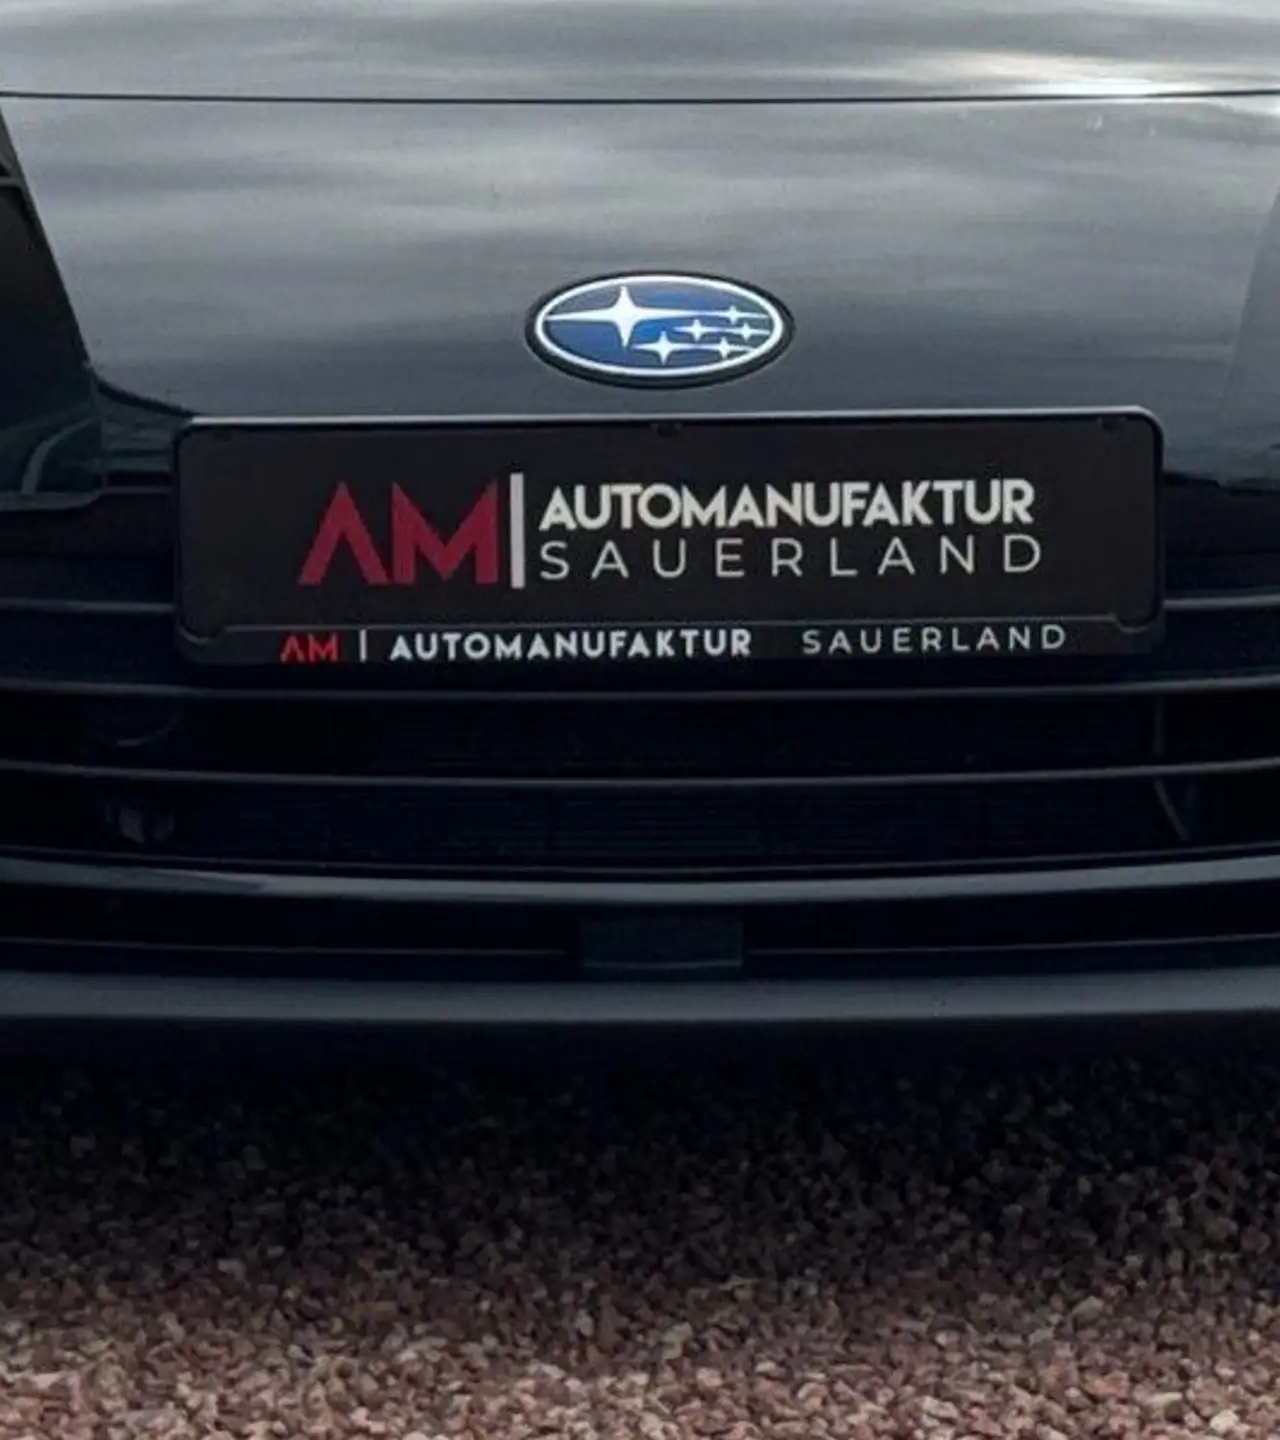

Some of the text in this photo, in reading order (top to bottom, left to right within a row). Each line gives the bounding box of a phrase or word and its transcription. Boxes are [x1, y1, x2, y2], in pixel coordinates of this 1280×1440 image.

[538, 479, 1036, 531] AUTOMANUFAKTUR
[299, 481, 498, 585] AM
[540, 534, 1042, 580] SAUERLAND
[280, 624, 1066, 662] AM AUTOMANUFAKTUR SAUERLAND
